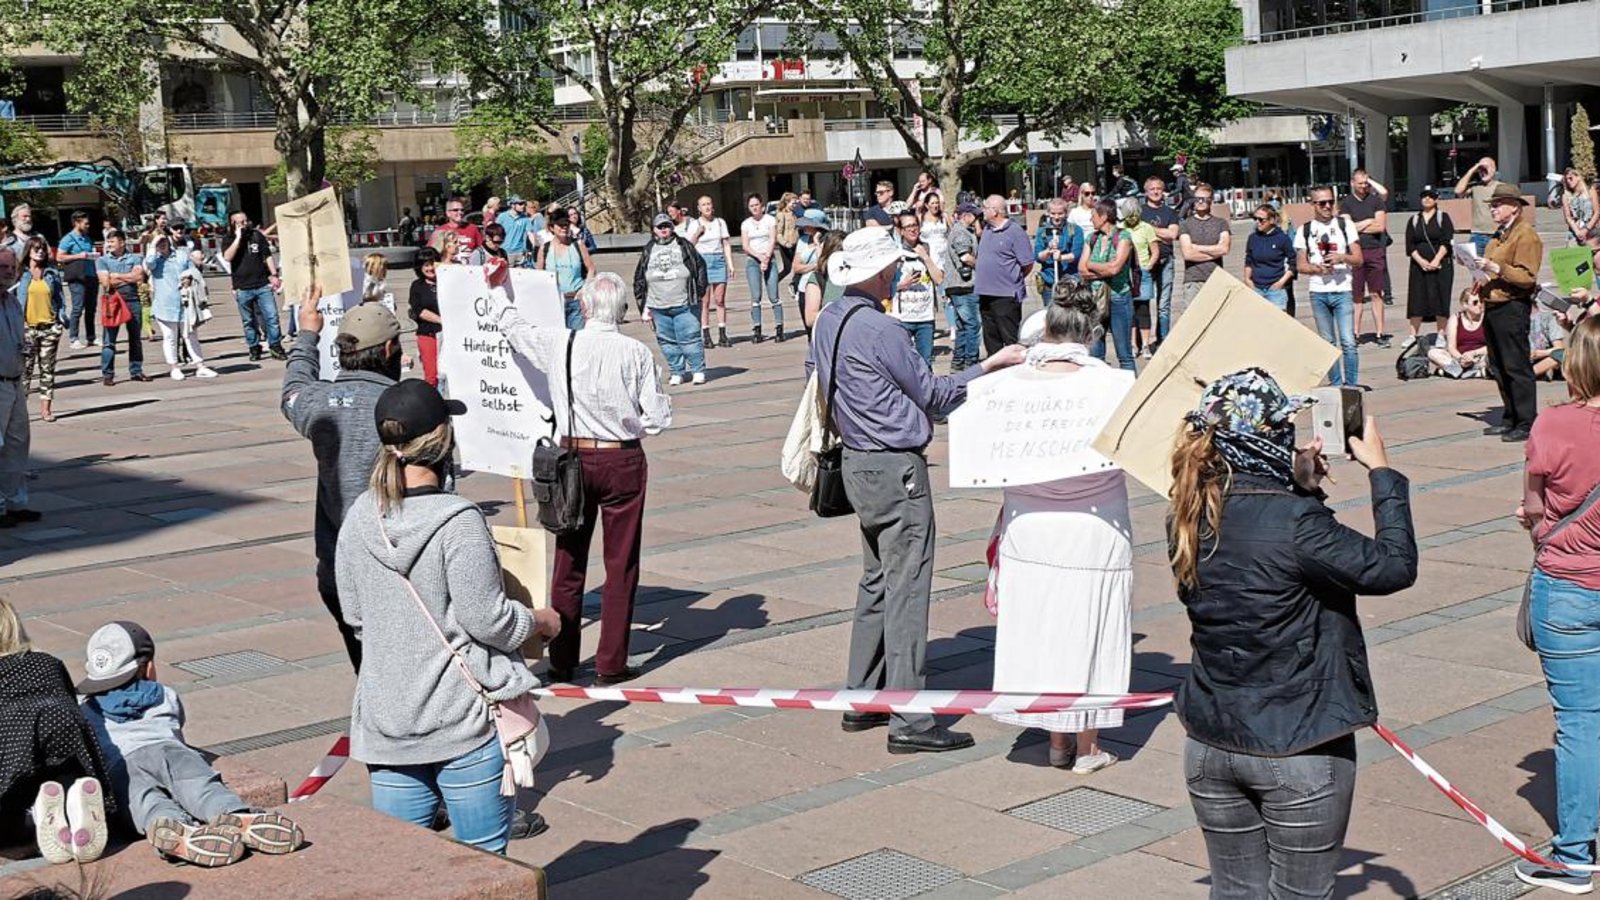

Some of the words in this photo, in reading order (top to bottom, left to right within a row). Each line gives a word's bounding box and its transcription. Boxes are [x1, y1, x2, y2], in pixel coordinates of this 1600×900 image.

[481, 355, 507, 369] alles
[480, 379, 518, 396] Denke
[481, 398, 524, 412] selbst
[986, 399, 1016, 414] DIE
